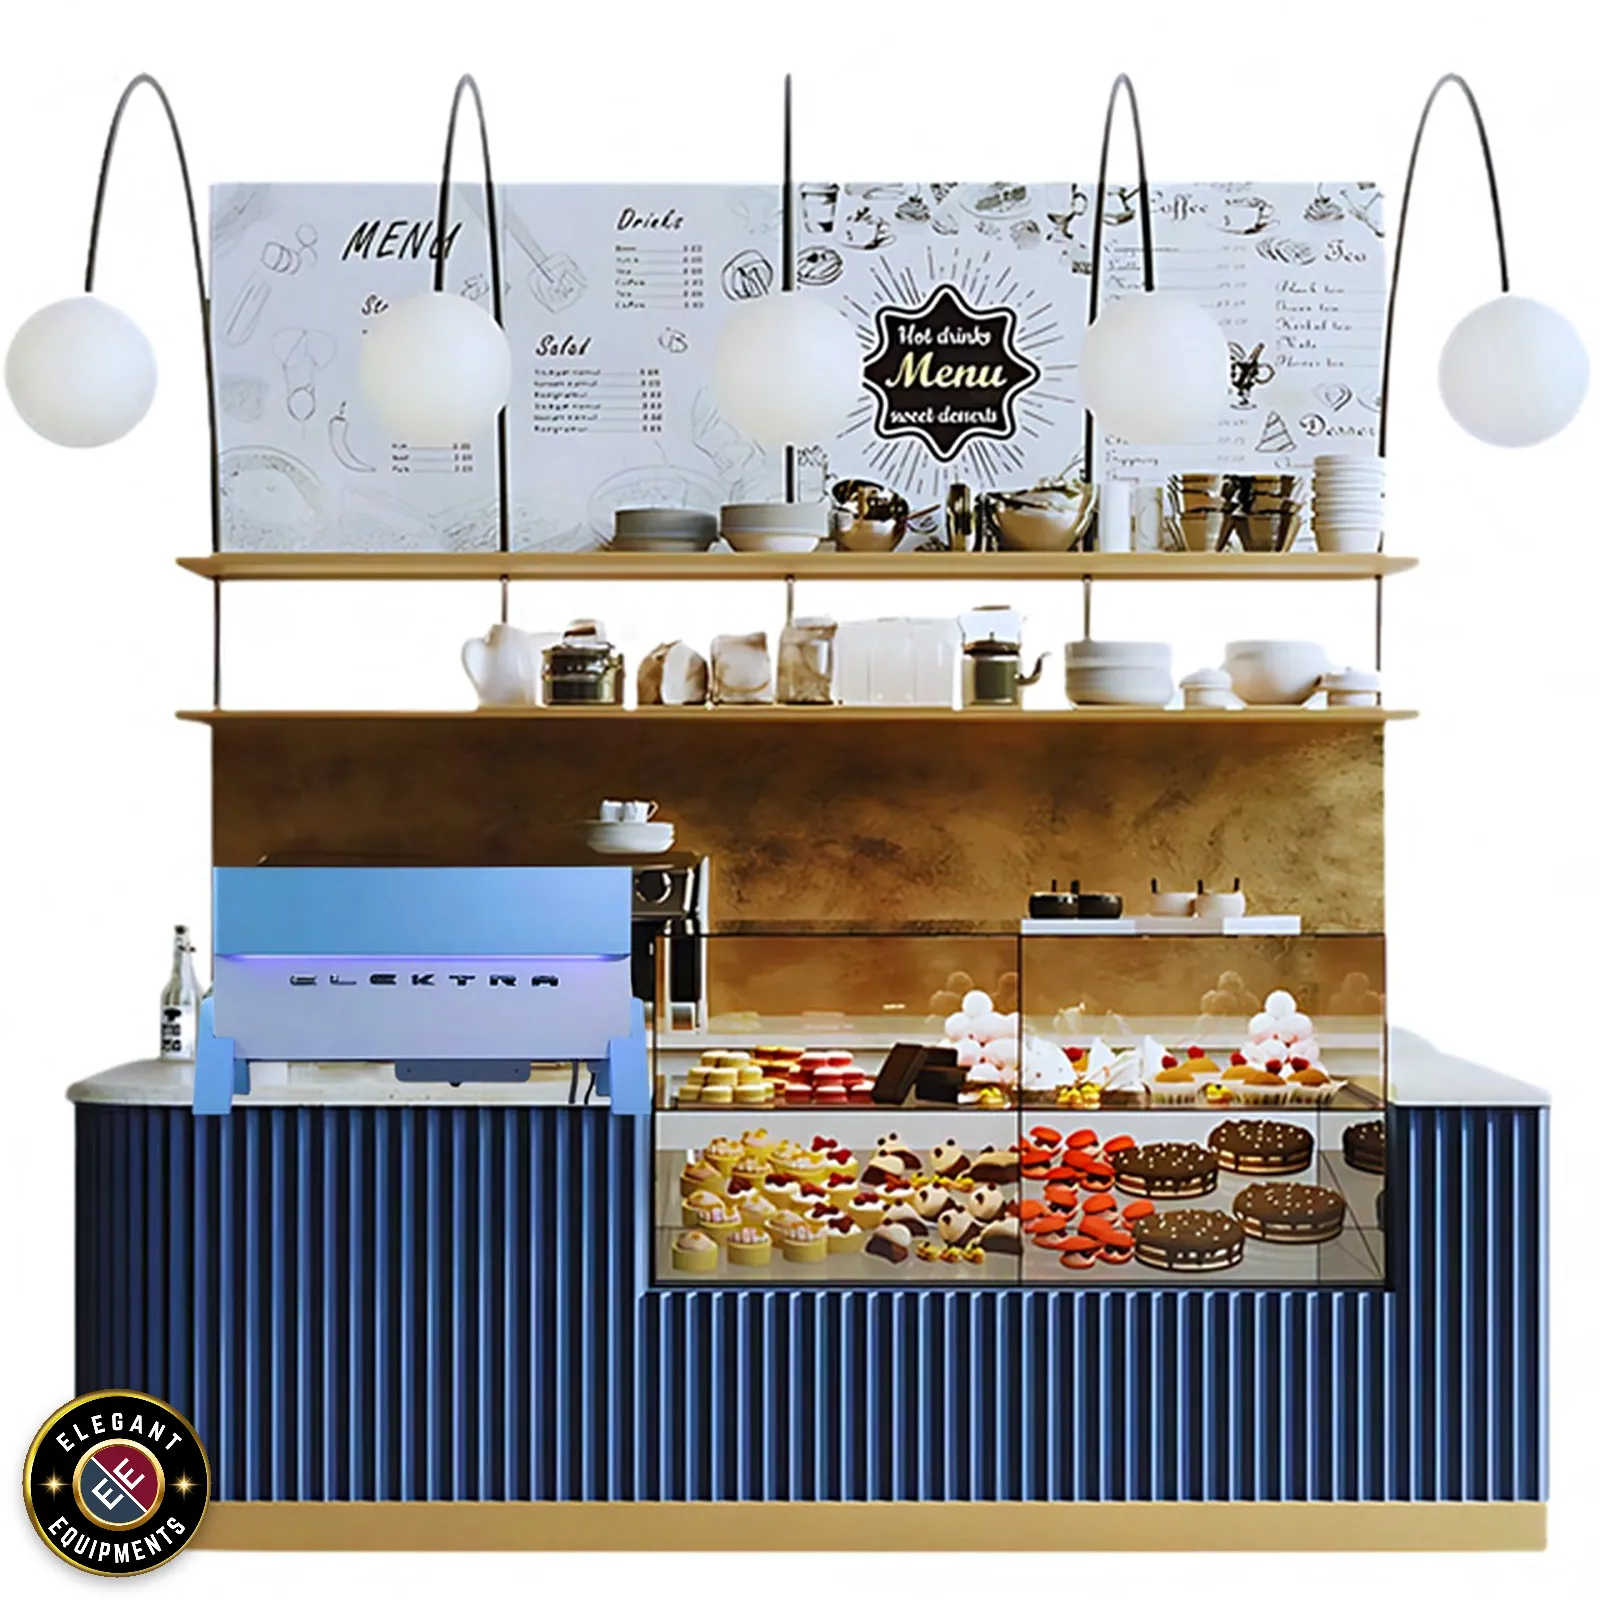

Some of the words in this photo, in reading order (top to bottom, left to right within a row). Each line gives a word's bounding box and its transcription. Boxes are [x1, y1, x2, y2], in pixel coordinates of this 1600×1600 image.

[341, 219, 463, 261] MENU
[897, 322, 933, 346] Hot
[936, 324, 992, 346] drinks
[884, 350, 1008, 389] Menu
[289, 973, 560, 987] ELEKTRA
